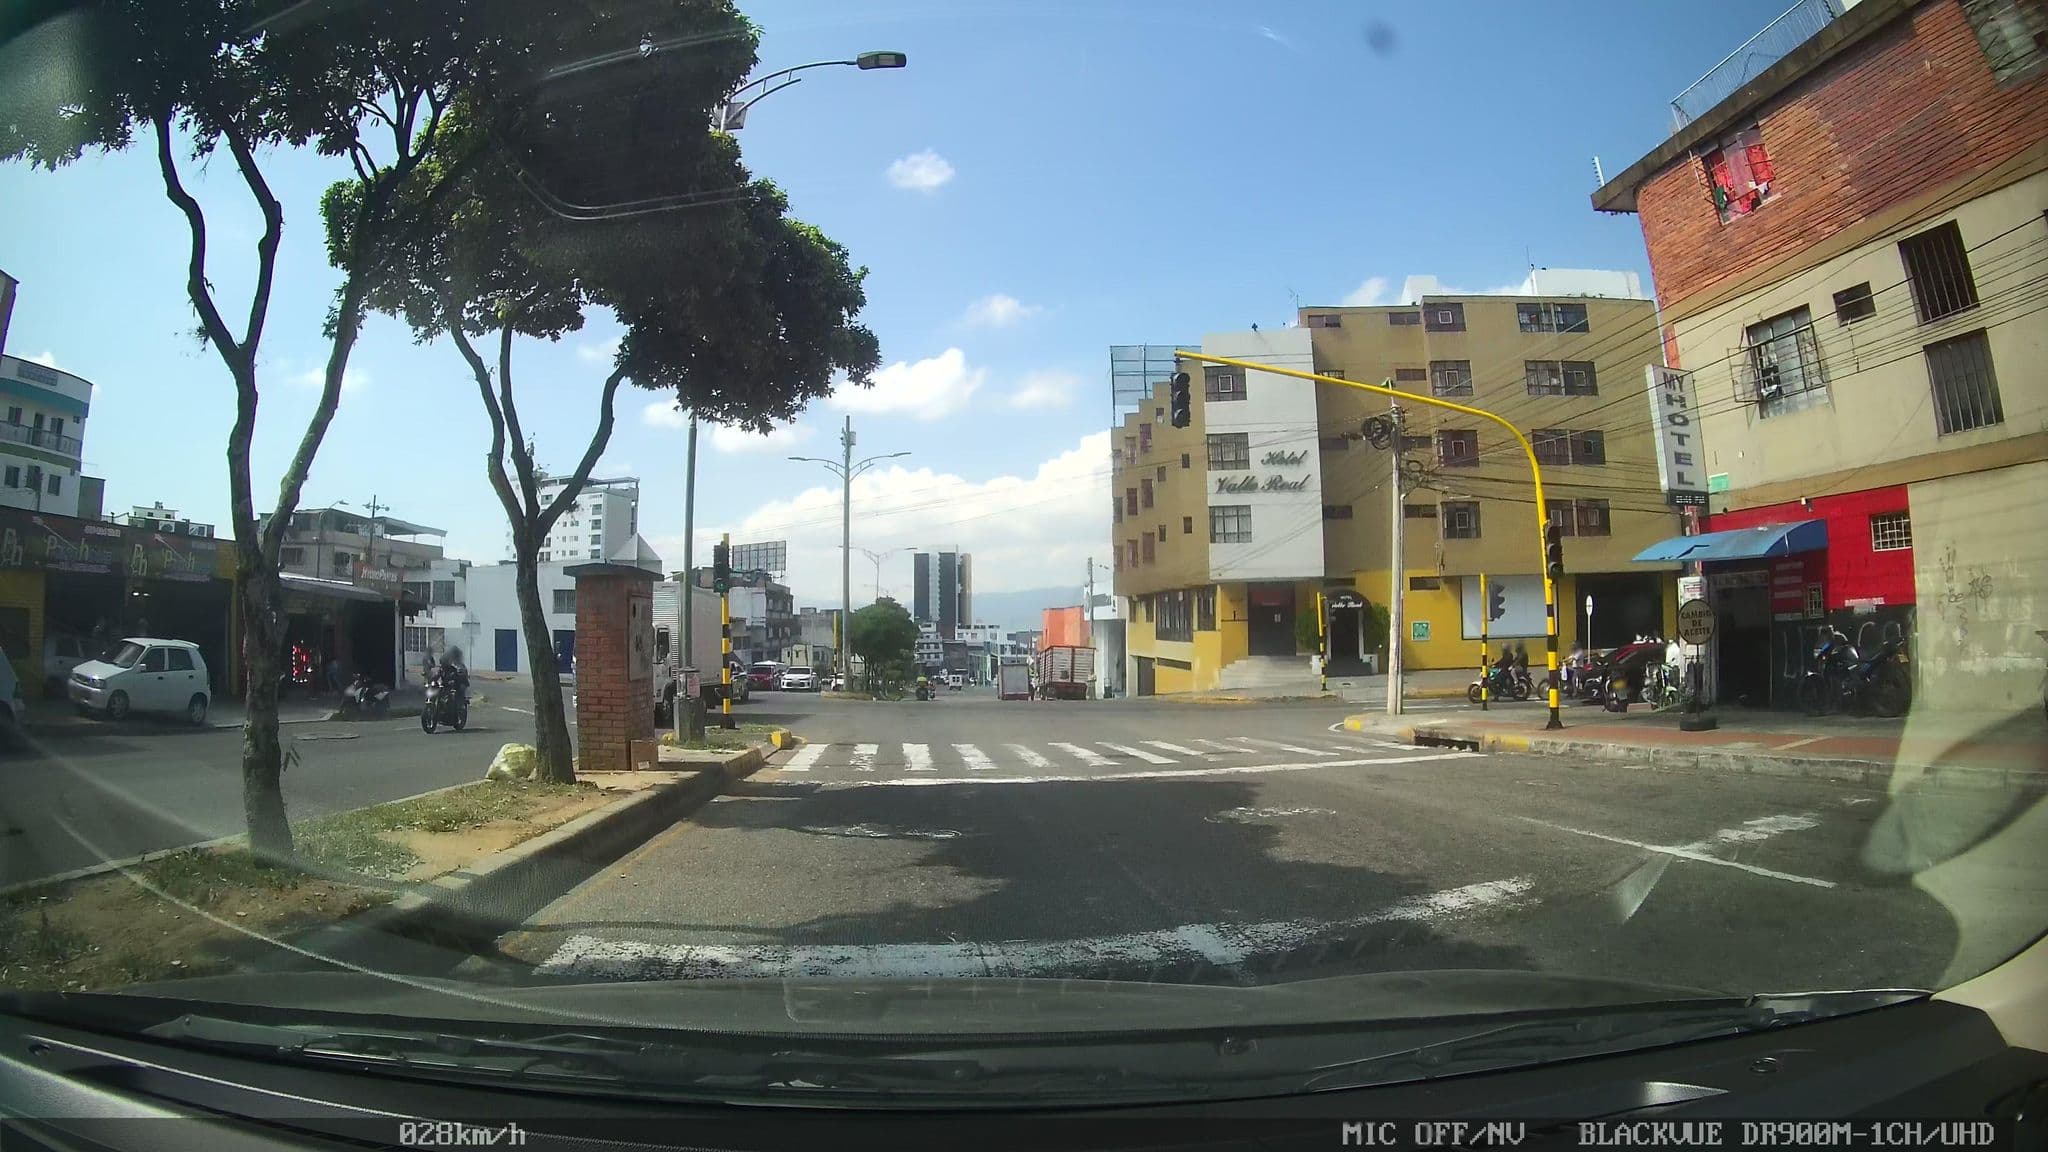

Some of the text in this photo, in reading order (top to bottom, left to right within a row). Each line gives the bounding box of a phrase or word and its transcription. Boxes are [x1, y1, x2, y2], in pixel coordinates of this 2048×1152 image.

[1666, 393, 1696, 487] HOTEL
[1261, 450, 1308, 466] Hotel
[1216, 473, 1311, 494] Valle Real
[1680, 609, 1712, 620] CAMBIO
[1691, 619, 1703, 628] DE
[1683, 626, 1712, 637] ACEITE
